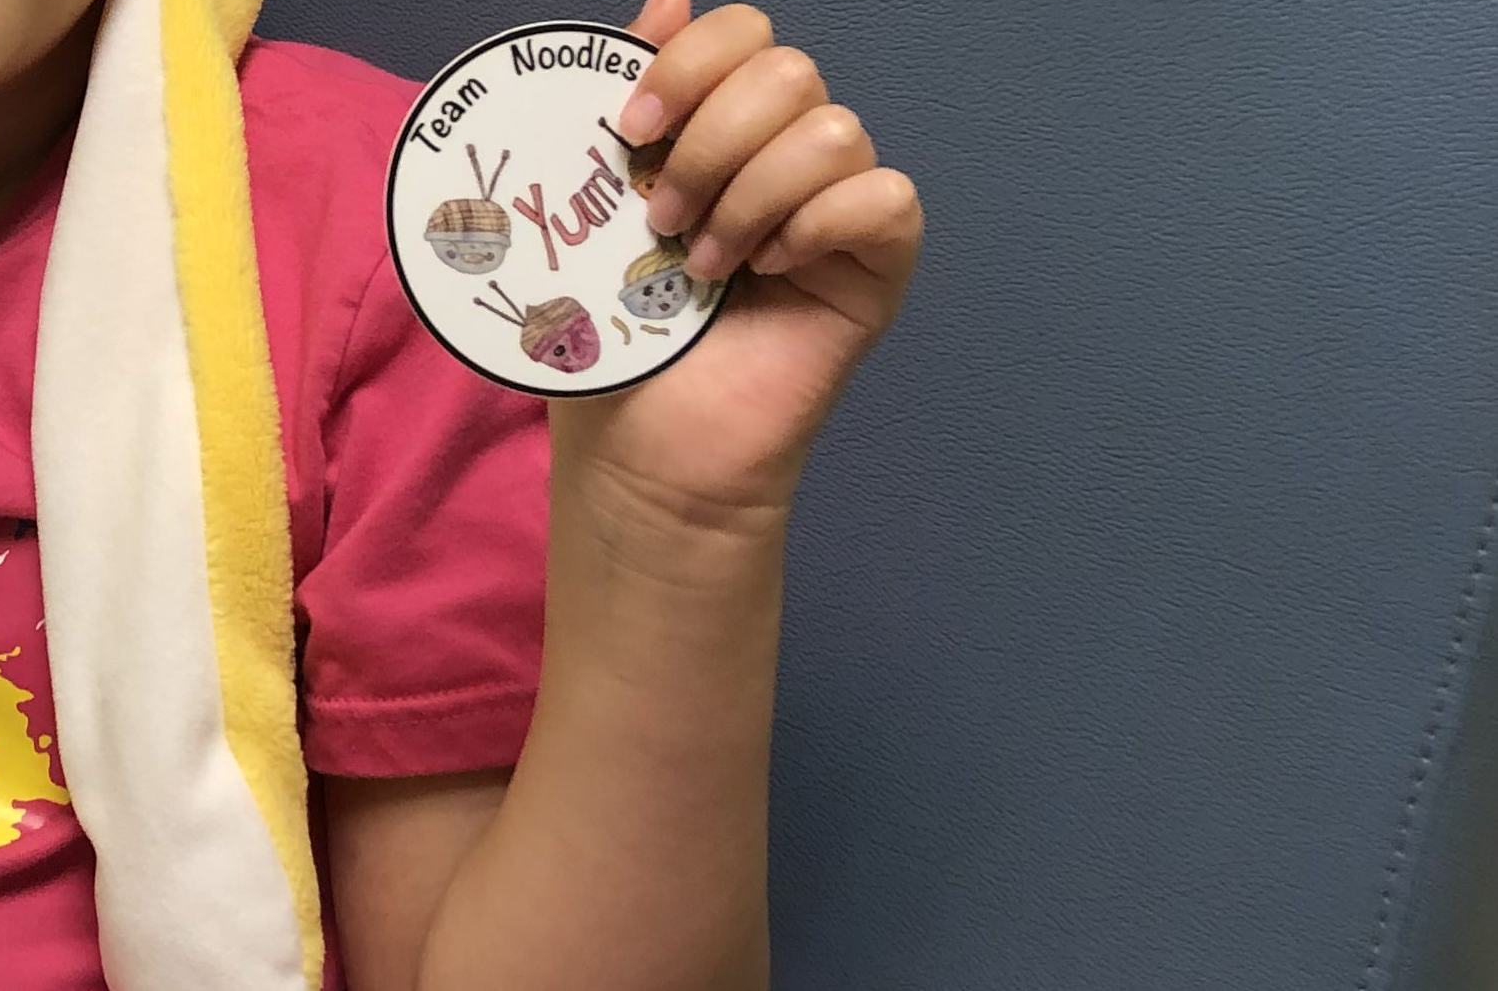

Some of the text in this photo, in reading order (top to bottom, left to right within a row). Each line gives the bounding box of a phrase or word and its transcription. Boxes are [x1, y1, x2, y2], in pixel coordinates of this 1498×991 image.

[409, 35, 642, 153] Team Noodles
[512, 145, 625, 272] Yum!
